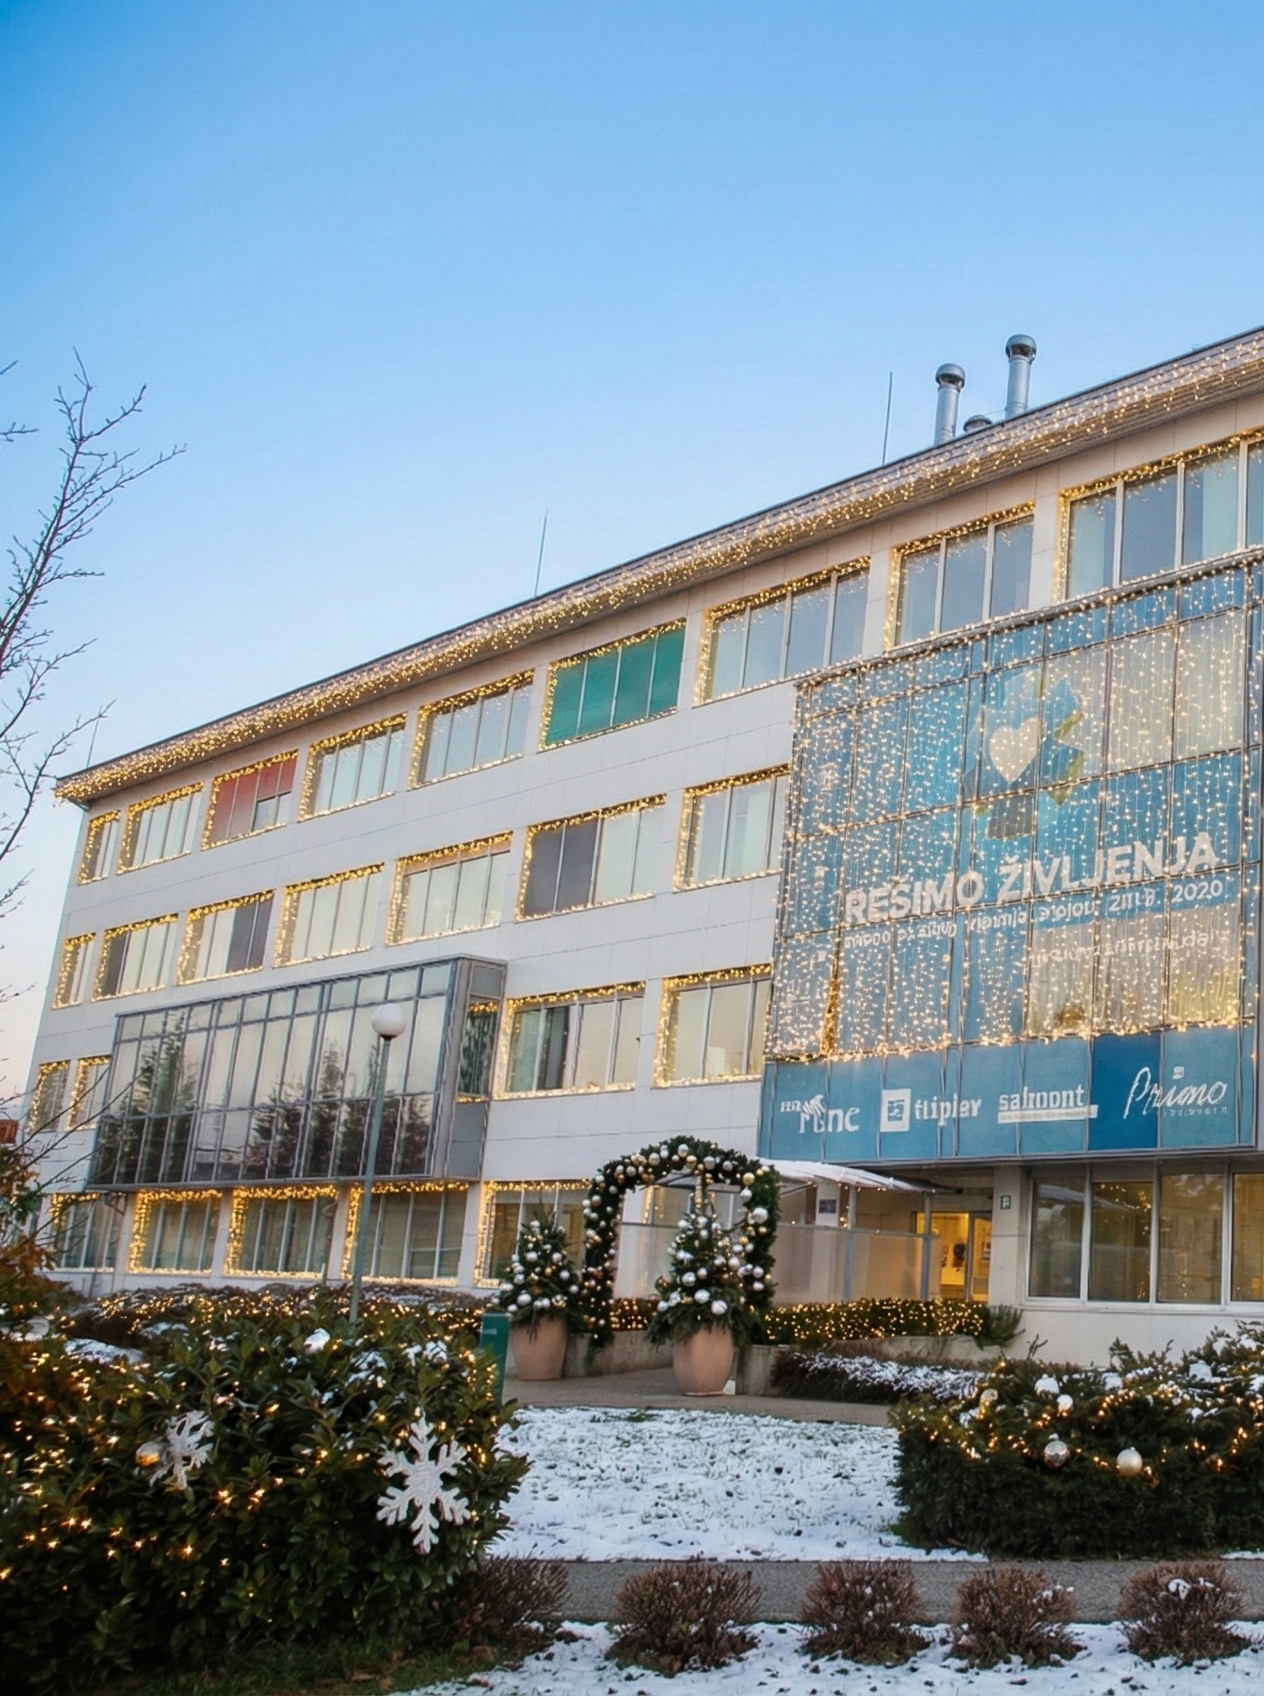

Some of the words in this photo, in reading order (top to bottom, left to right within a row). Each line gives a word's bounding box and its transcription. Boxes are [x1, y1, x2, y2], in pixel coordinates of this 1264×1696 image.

[845, 871, 984, 924] REŠIMO
[997, 831, 1218, 904] ŽIVLJENJA
[1171, 879, 1223, 903] 2020
[1123, 1066, 1227, 1119] Primo
